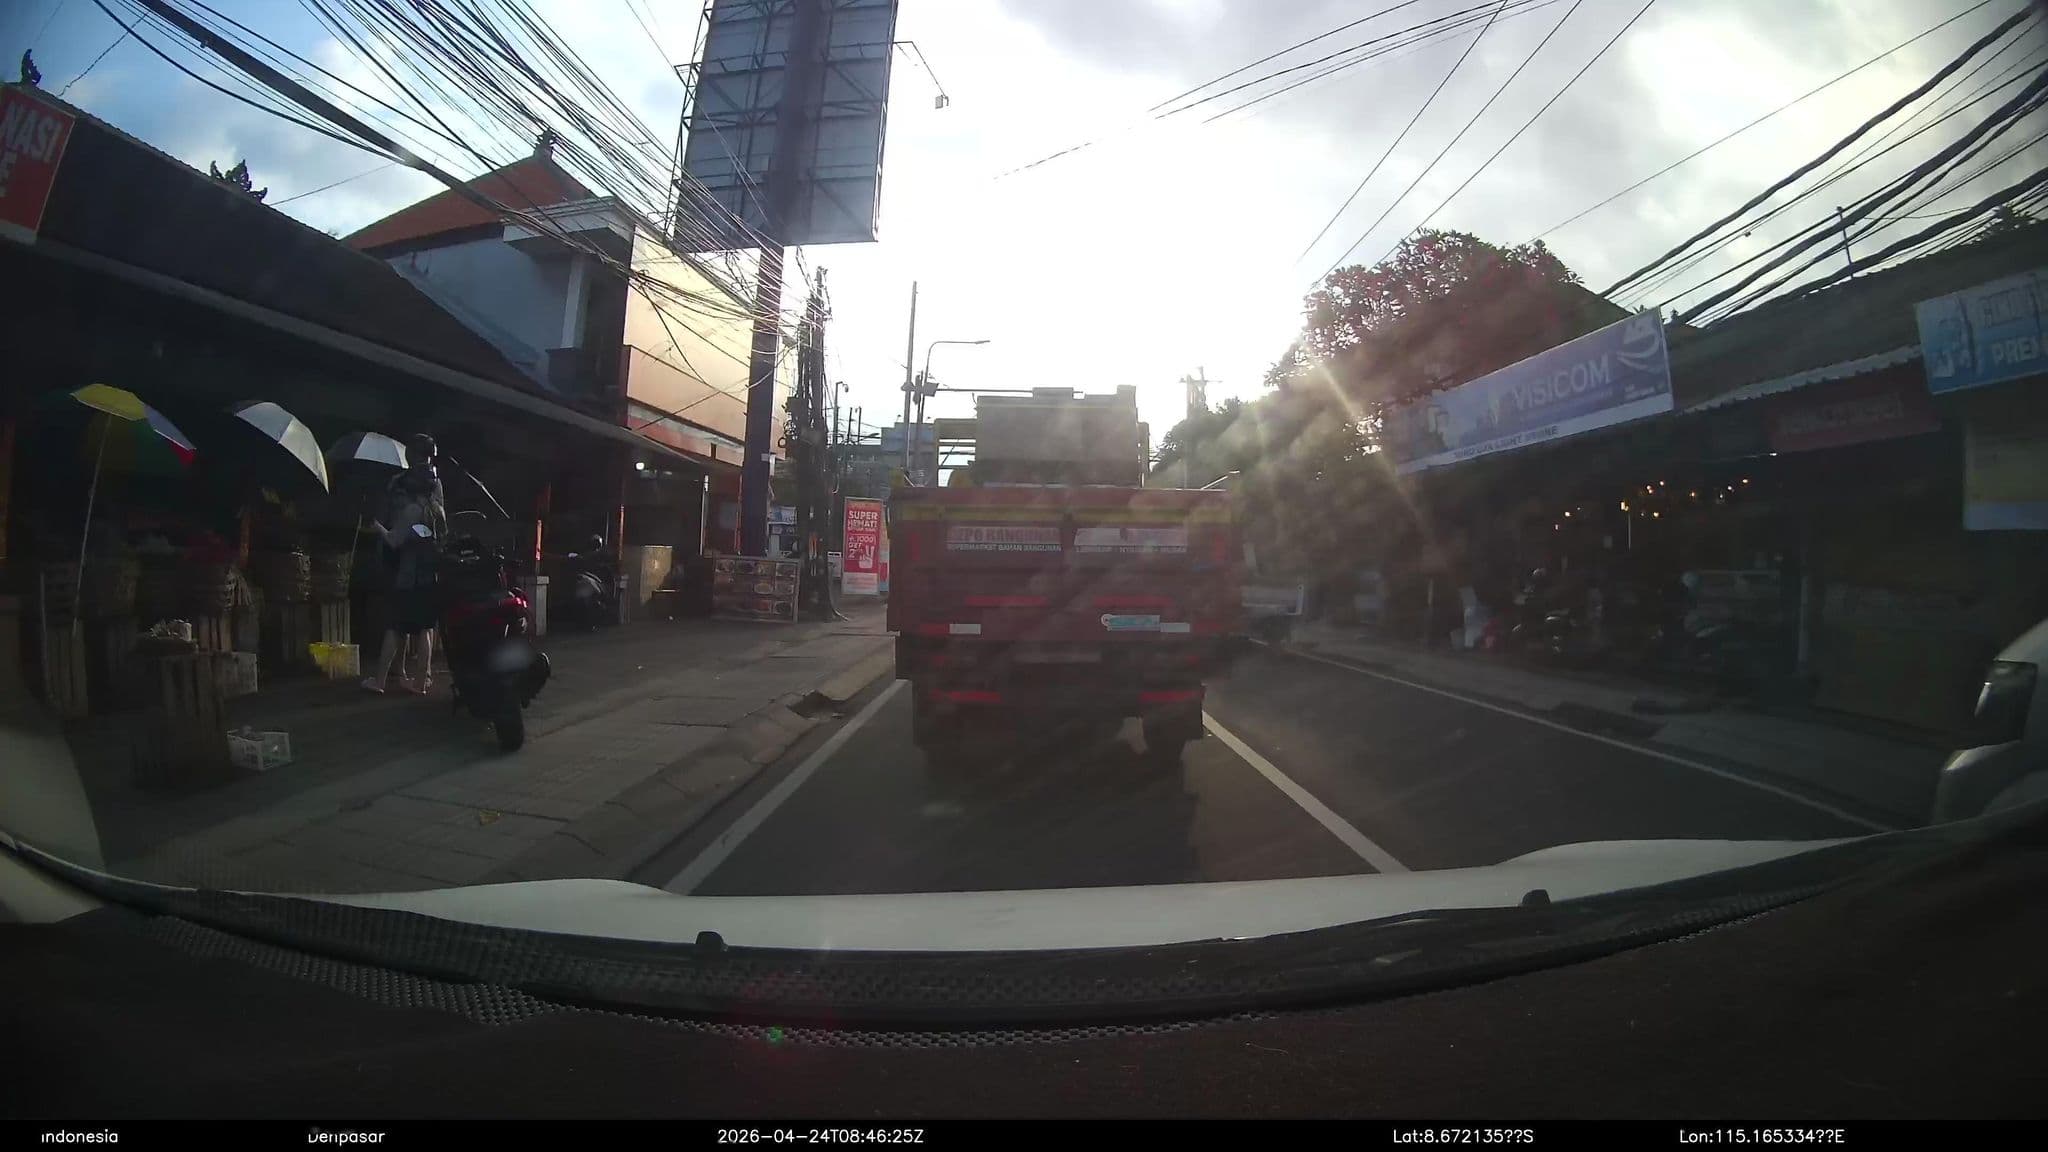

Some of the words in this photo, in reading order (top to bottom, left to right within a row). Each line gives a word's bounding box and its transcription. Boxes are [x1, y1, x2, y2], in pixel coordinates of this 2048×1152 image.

[0, 101, 63, 163] NASI
[1511, 353, 1611, 410] VISICOM
[849, 510, 878, 520] SUPER
